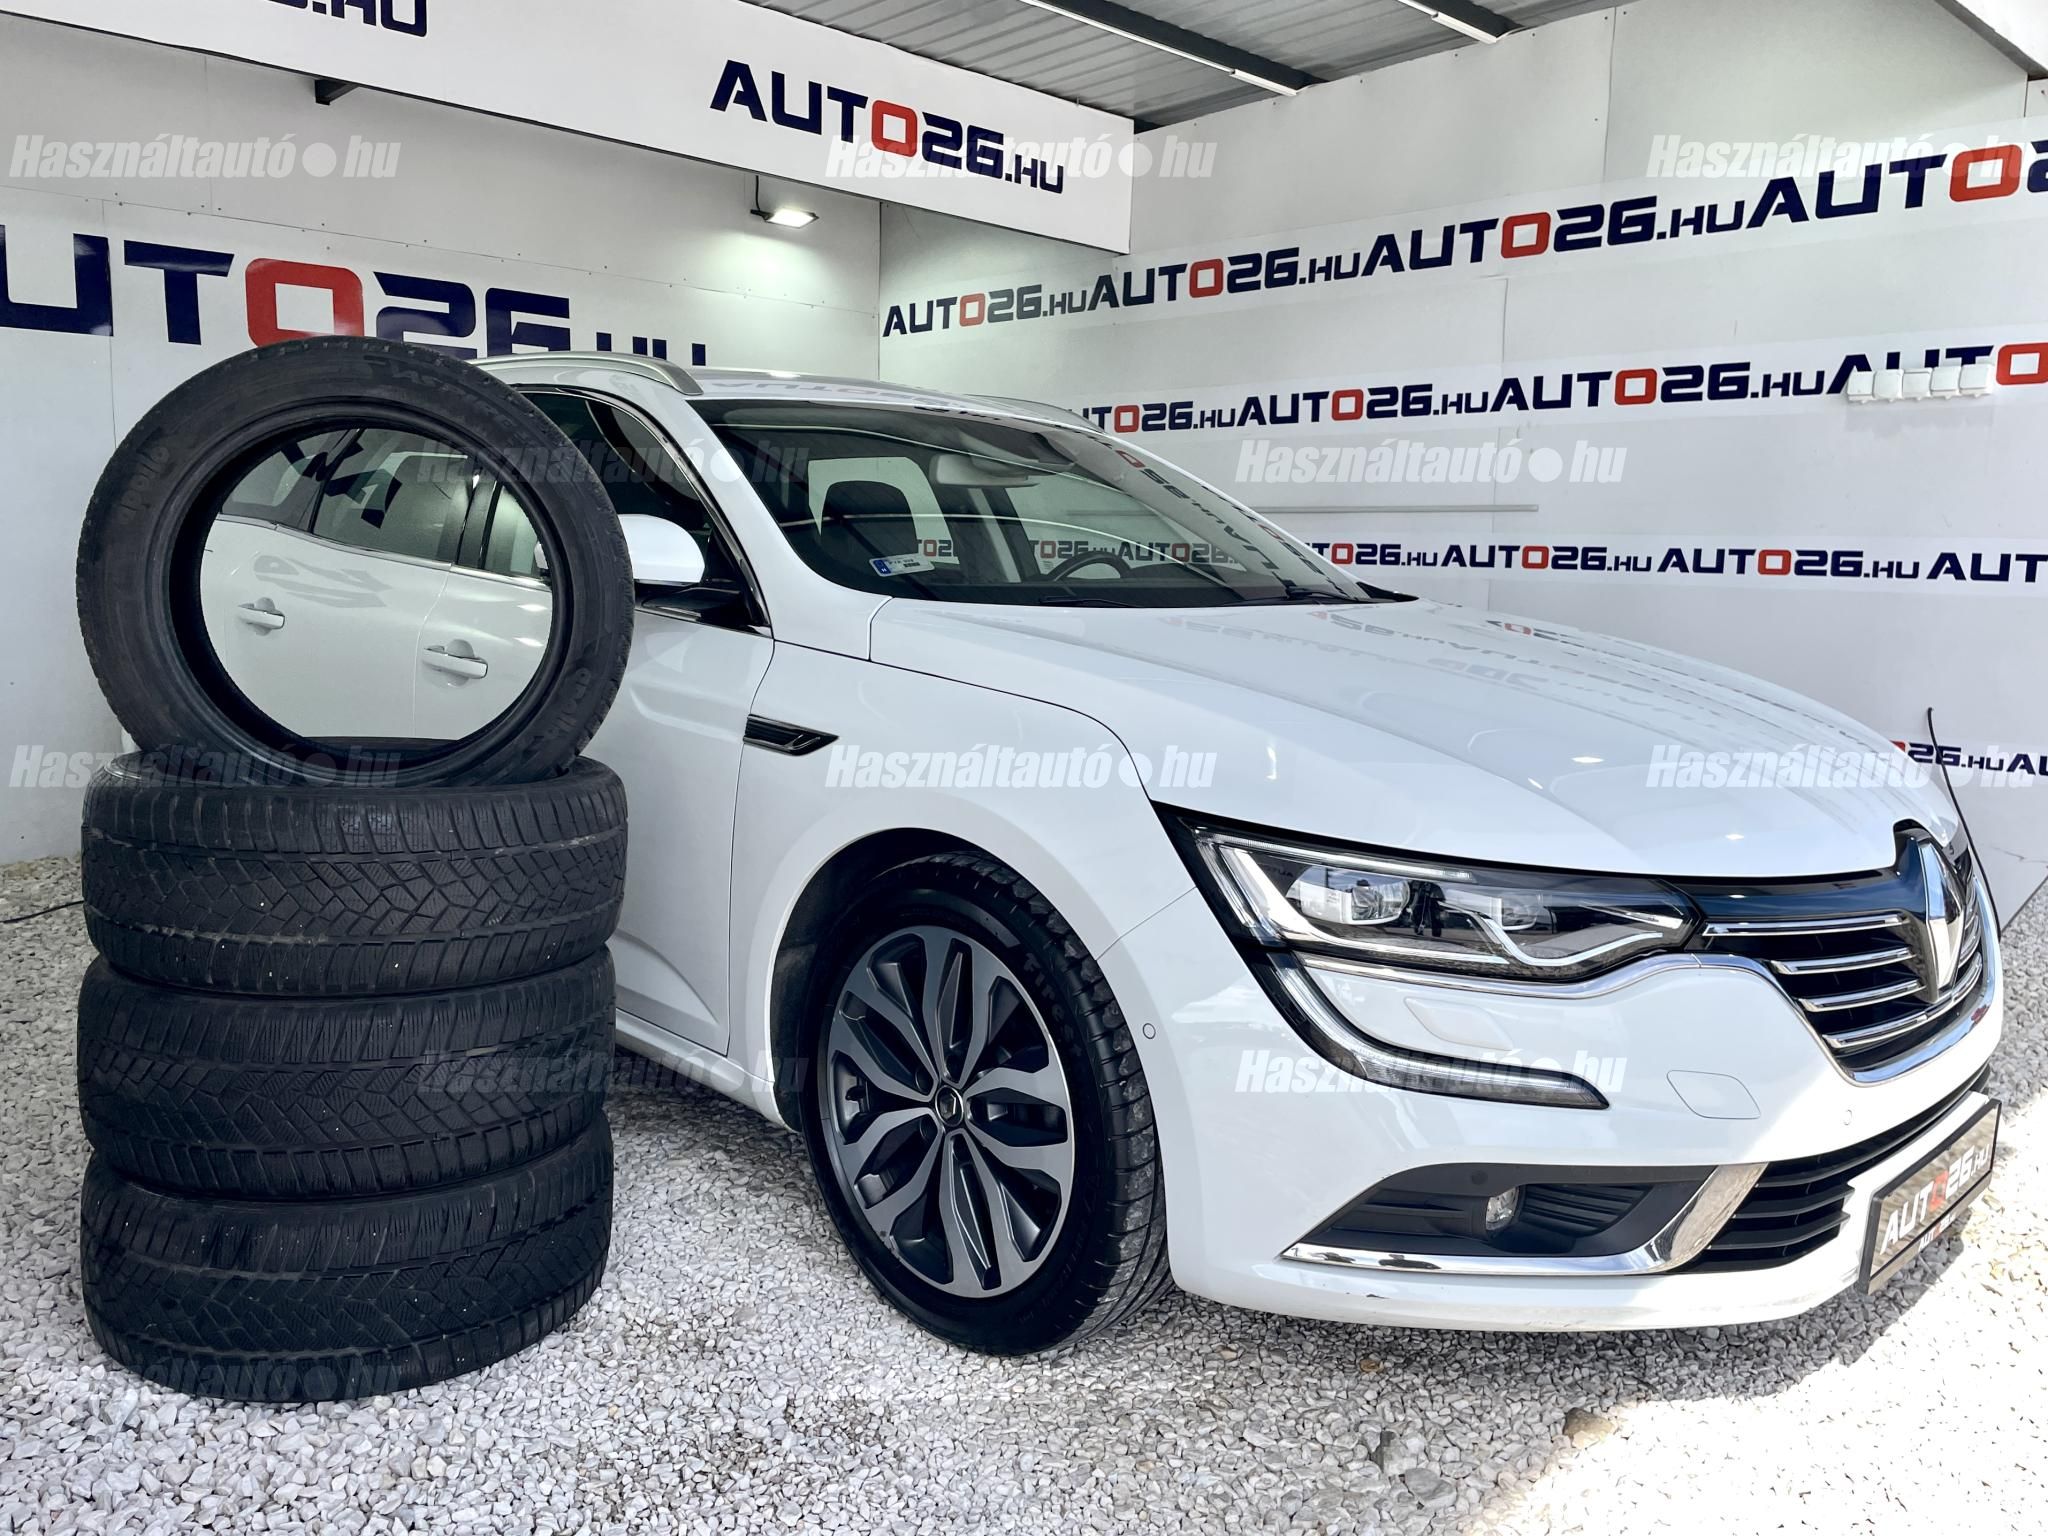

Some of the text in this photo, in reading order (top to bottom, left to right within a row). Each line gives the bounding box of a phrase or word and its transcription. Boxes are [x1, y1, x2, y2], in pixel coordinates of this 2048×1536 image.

[709, 59, 1064, 194] AUTO26.HU
[883, 285, 1087, 337] AUTO26.HU
[1088, 247, 1360, 310] AUTO26.HU
[1361, 196, 1745, 277] AUTO26.HU
[1237, 384, 1489, 426] AUTO26.HU
[1490, 362, 1825, 412] AUTO26.HU
[1441, 544, 1651, 571] AUTO26.HU
[1658, 548, 1920, 578] AUTO26.HU
